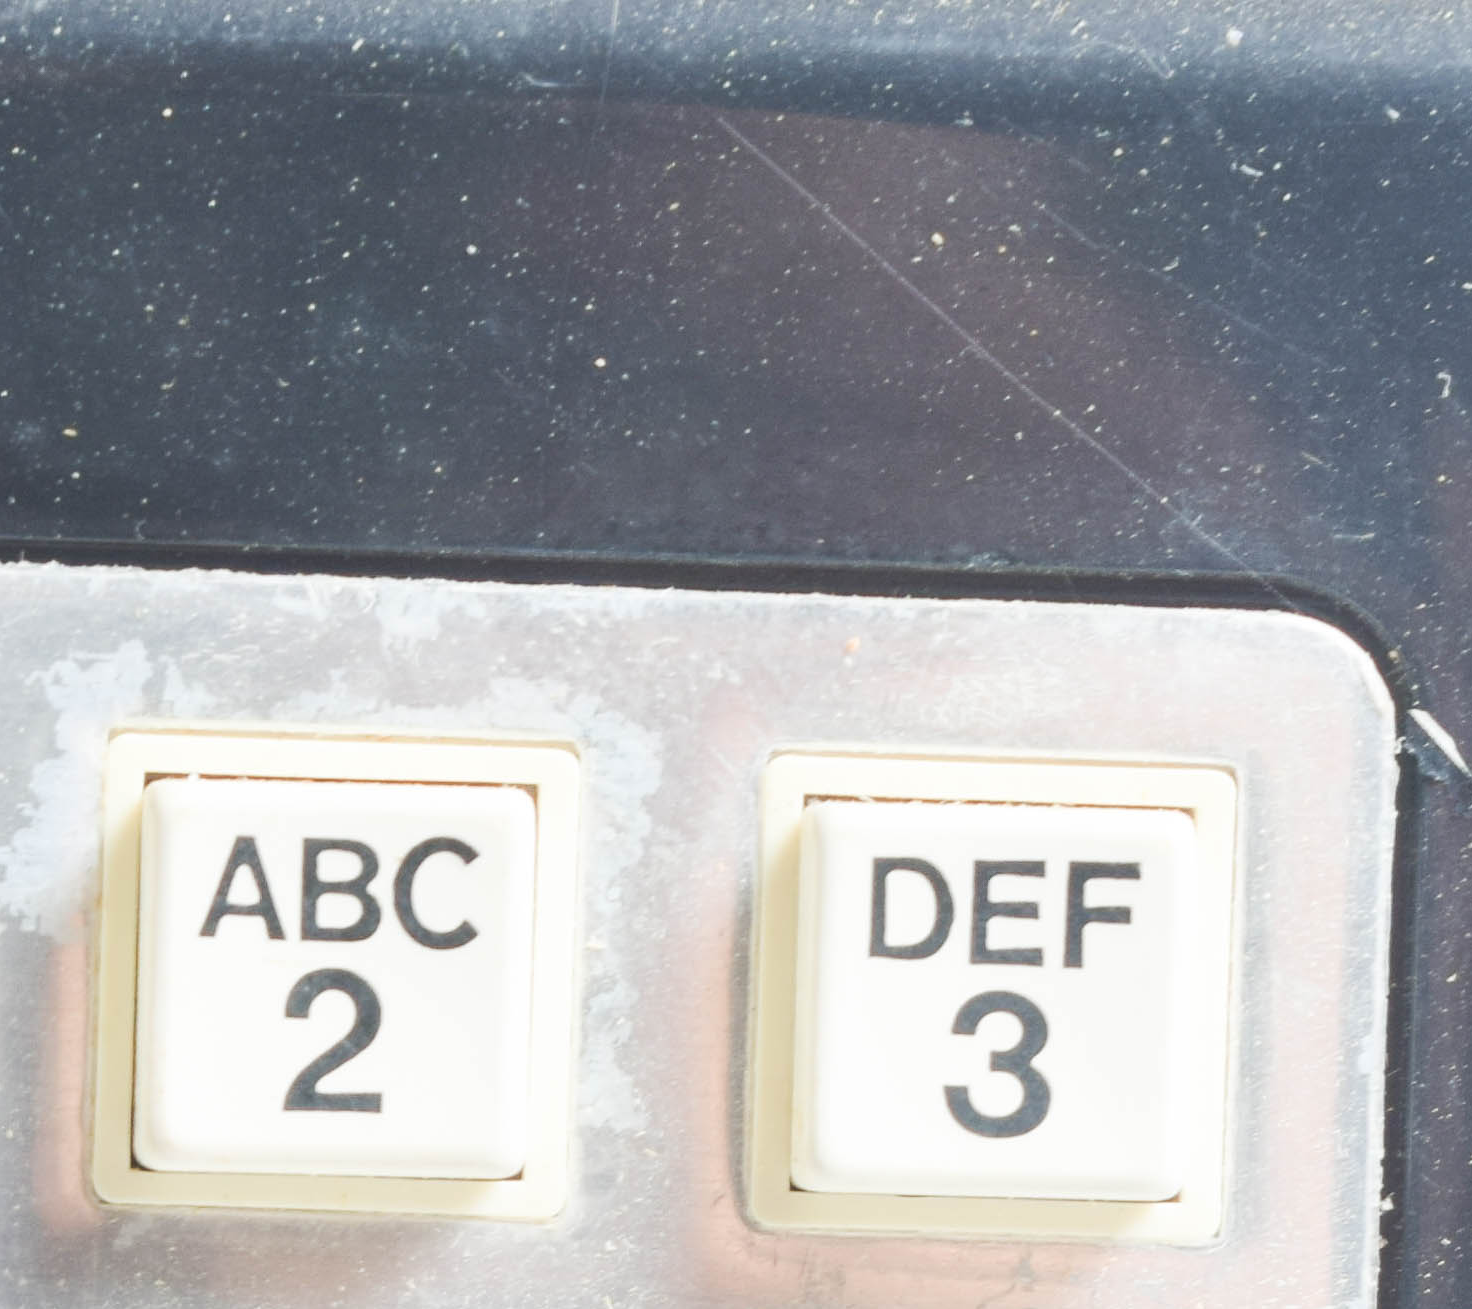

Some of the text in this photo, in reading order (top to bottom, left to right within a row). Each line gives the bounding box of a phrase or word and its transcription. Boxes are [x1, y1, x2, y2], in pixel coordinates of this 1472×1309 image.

[199, 836, 480, 951] ABC
[869, 856, 1142, 969] DEF
[284, 967, 382, 1114] 2
[945, 990, 1051, 1139] 3
